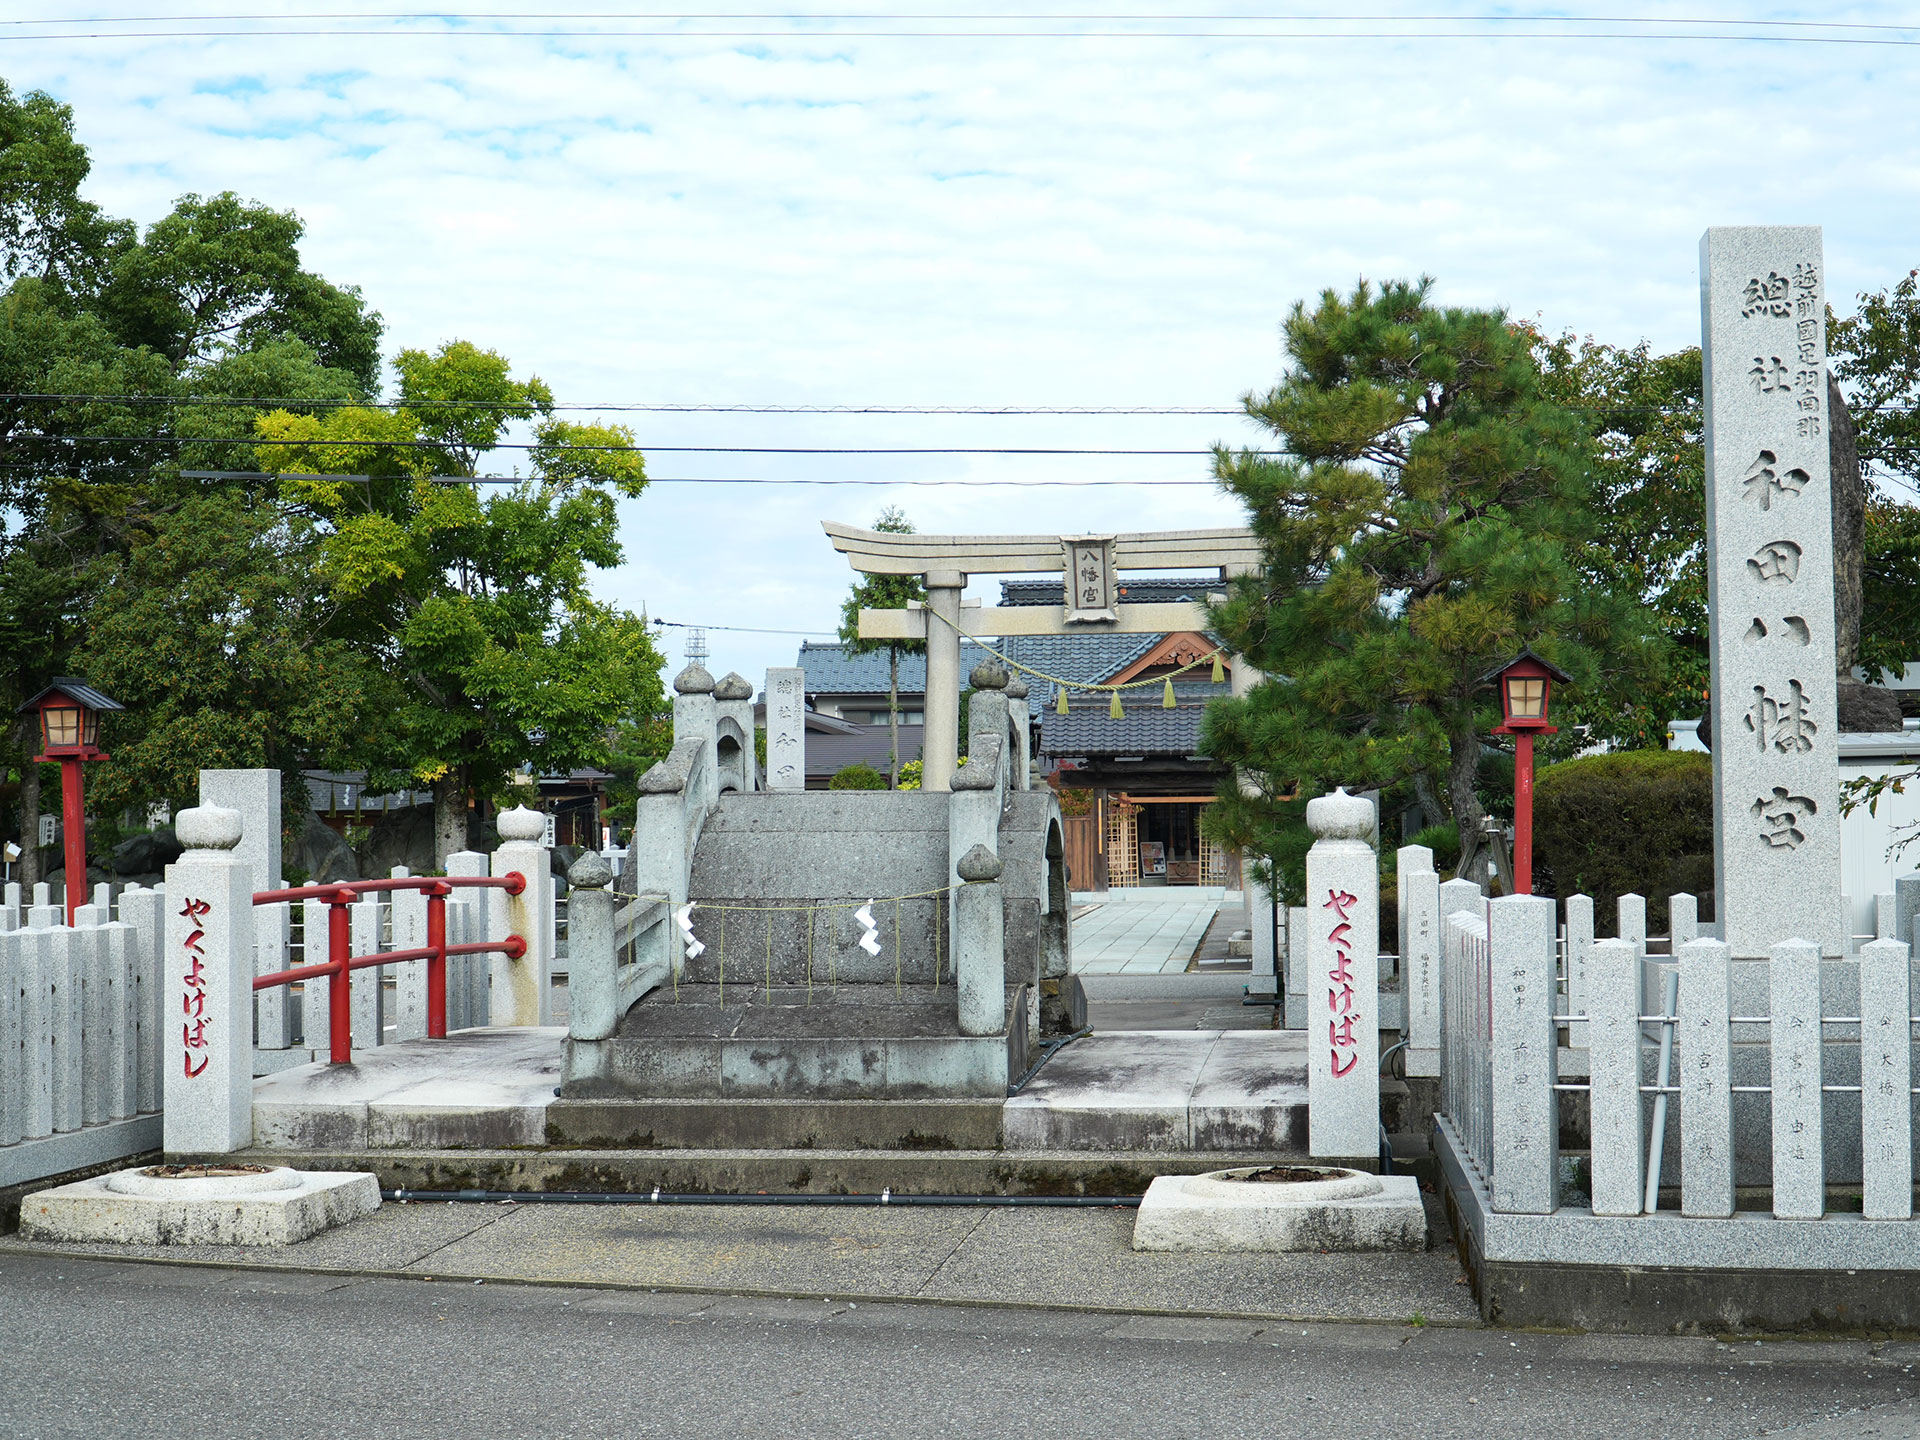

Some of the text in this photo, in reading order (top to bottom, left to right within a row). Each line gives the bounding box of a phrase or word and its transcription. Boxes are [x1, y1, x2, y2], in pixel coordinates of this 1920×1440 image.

[1081, 550, 1100, 603] 八幡宮
[1741, 270, 1818, 851] 總社和田八幡宮
[178, 896, 212, 1080] やくよけばし
[1323, 888, 1360, 1079] やくよけばし
